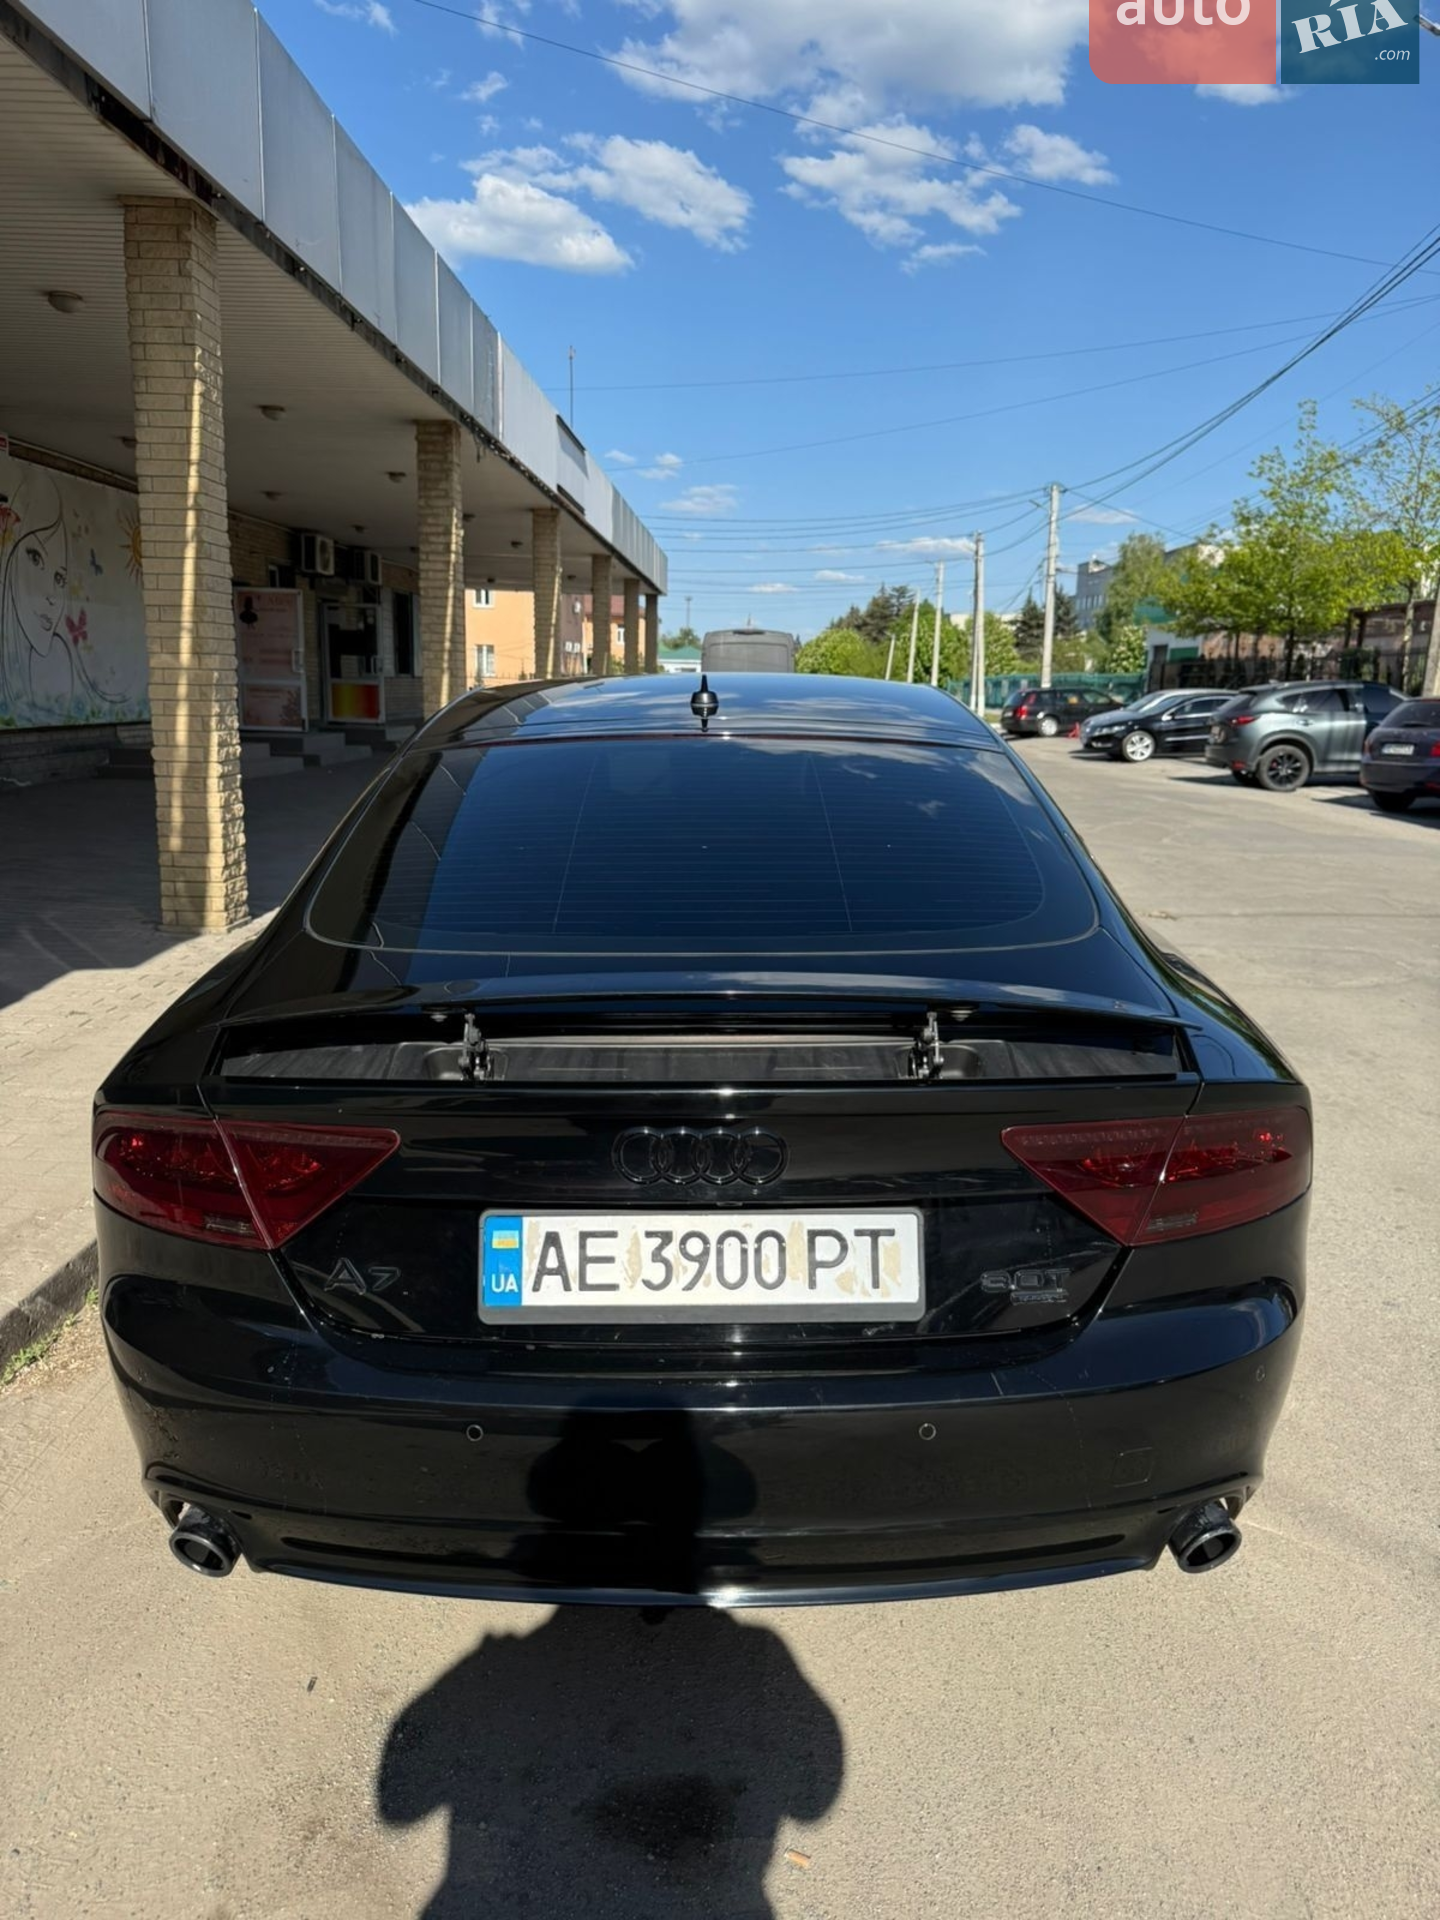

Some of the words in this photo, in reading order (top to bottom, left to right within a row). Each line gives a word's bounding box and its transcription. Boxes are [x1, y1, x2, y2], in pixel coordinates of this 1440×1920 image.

[323, 1257, 401, 1296] A7
[531, 1229, 620, 1293] AE
[641, 1228, 788, 1293] 3900
[806, 1228, 896, 1291] PT
[490, 1273, 519, 1293] UA
